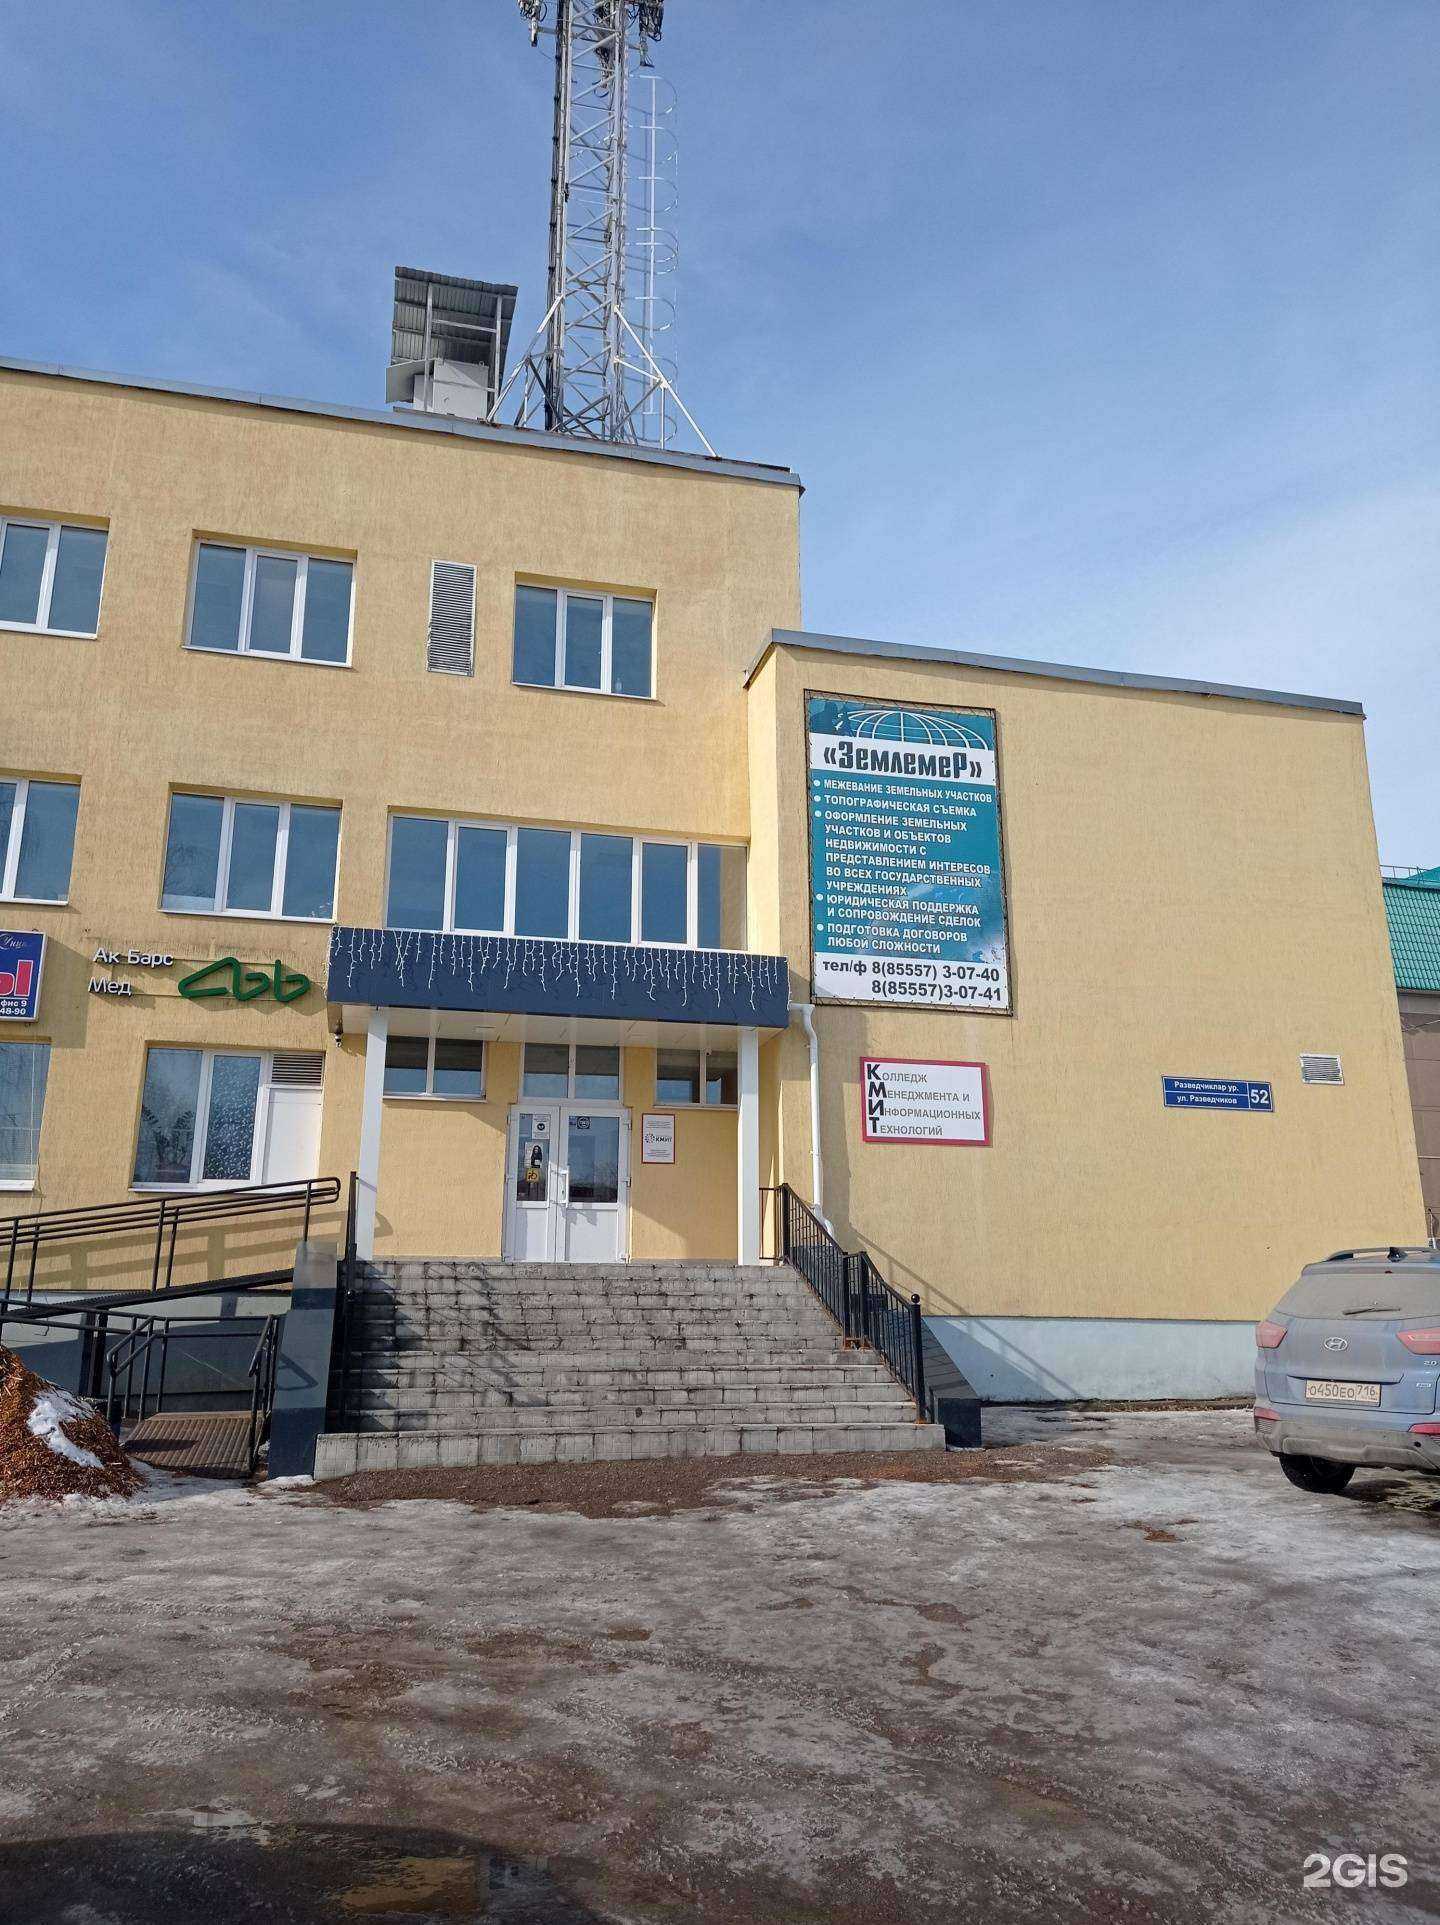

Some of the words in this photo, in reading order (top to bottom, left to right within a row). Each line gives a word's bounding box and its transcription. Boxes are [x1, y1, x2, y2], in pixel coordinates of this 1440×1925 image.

[824, 779, 882, 794] МЕЖЕВАНИЕ
[886, 785, 943, 799] ЗЕМЕЛЬНЫХ
[945, 790, 992, 803] УЧАСТКОВ
[825, 795, 929, 812] ТОПОГРАФИЧЕСКАЯ
[933, 805, 977, 817] СЪЕМКА
[825, 811, 899, 825] ОФОРМЛЕНИЕ
[902, 818, 967, 831] ЗЕМЕЛЬНЫХ
[825, 825, 880, 838] УЧАСТКОВ
[884, 829, 891, 838] И
[895, 831, 951, 843] ОБЪЕКТОВ
[825, 839, 916, 855] НЕДВИЖИМОСТИ
[920, 846, 927, 855] С
[826, 853, 926, 869] ПРЕДСТАВЛЕНИЕМ
[929, 861, 990, 874] ИНТЕРЕСОВ
[827, 867, 841, 877] ВО
[844, 868, 872, 879] ВСЕХ
[876, 871, 981, 887] ГОСУДАРСТВЕННЫХ
[826, 881, 907, 896] УЧРЕЖДЕНИЯХ
[827, 895, 909, 909] ЮРИДИЧЕСКАЯ
[913, 902, 979, 914] ПОДДЕРЖКА
[828, 908, 834, 917] И
[838, 908, 935, 924] СОПРОВОЖДЕНИЕ
[938, 916, 981, 927] СДЕЛОК
[828, 924, 900, 937] ПОДГОТОВКА
[903, 930, 967, 942] ДОГОВОРОВ
[828, 937, 868, 948] ЛЮБОЙ
[872, 940, 941, 954] СЛОЖНОСТИ
[93, 947, 119, 963] Ак
[128, 949, 173, 968] Барс
[823, 960, 866, 975] тел/ф
[872, 962, 937, 980] 8(85557)
[943, 966, 999, 982] 3-07-40
[88, 976, 131, 995] Мед
[1175, 1081, 1226, 1091] Разведчиклар
[1190, 1095, 1237, 1104] Разведчиков
[1251, 1090, 1269, 1103] 52
[1356, 1384, 1376, 1396] 716
